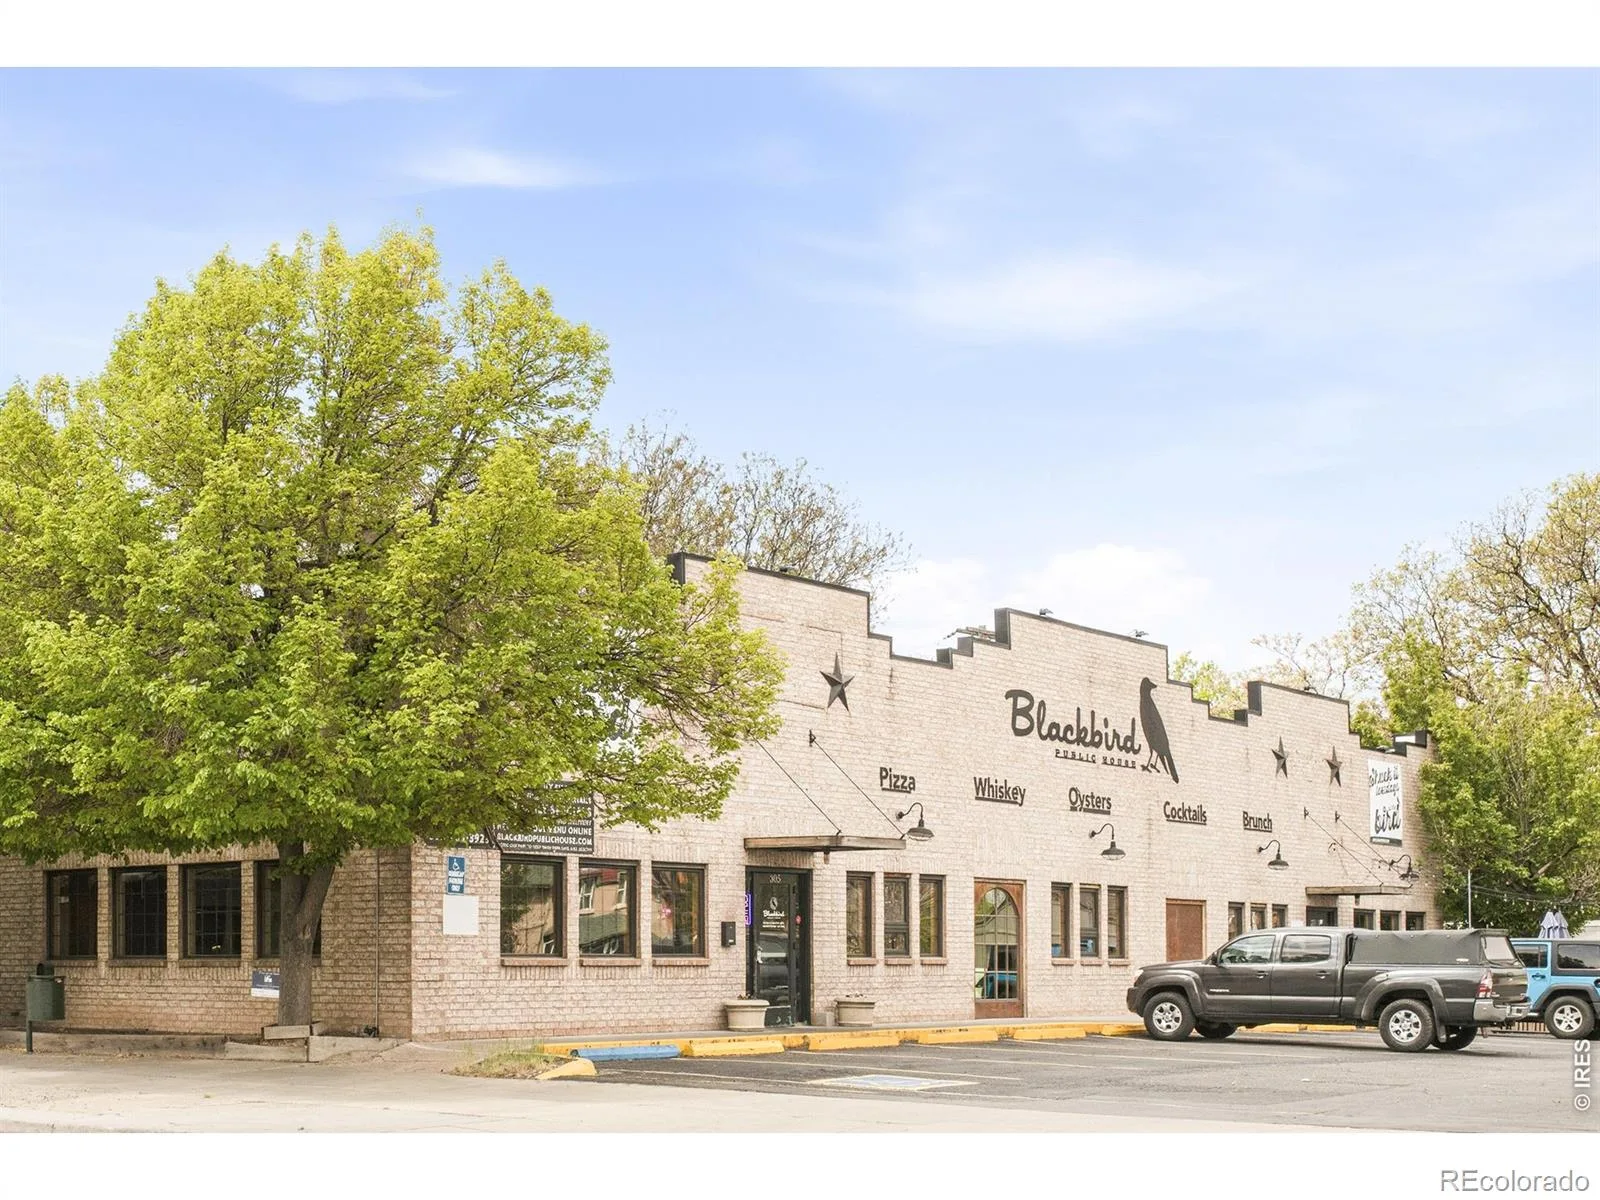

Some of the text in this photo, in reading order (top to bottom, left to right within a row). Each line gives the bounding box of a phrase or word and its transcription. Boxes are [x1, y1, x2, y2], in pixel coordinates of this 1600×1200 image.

[1005, 689, 1141, 755] Blackbird
[1055, 749, 1136, 769] PUBLIC HOUSE
[880, 767, 916, 791] Pizza
[974, 776, 1026, 806] Whiskey
[1068, 787, 1112, 812] Oysters
[1163, 801, 1208, 823] Cocktails
[1242, 811, 1273, 830] Brunch
[568, 826, 592, 836] ONLINE
